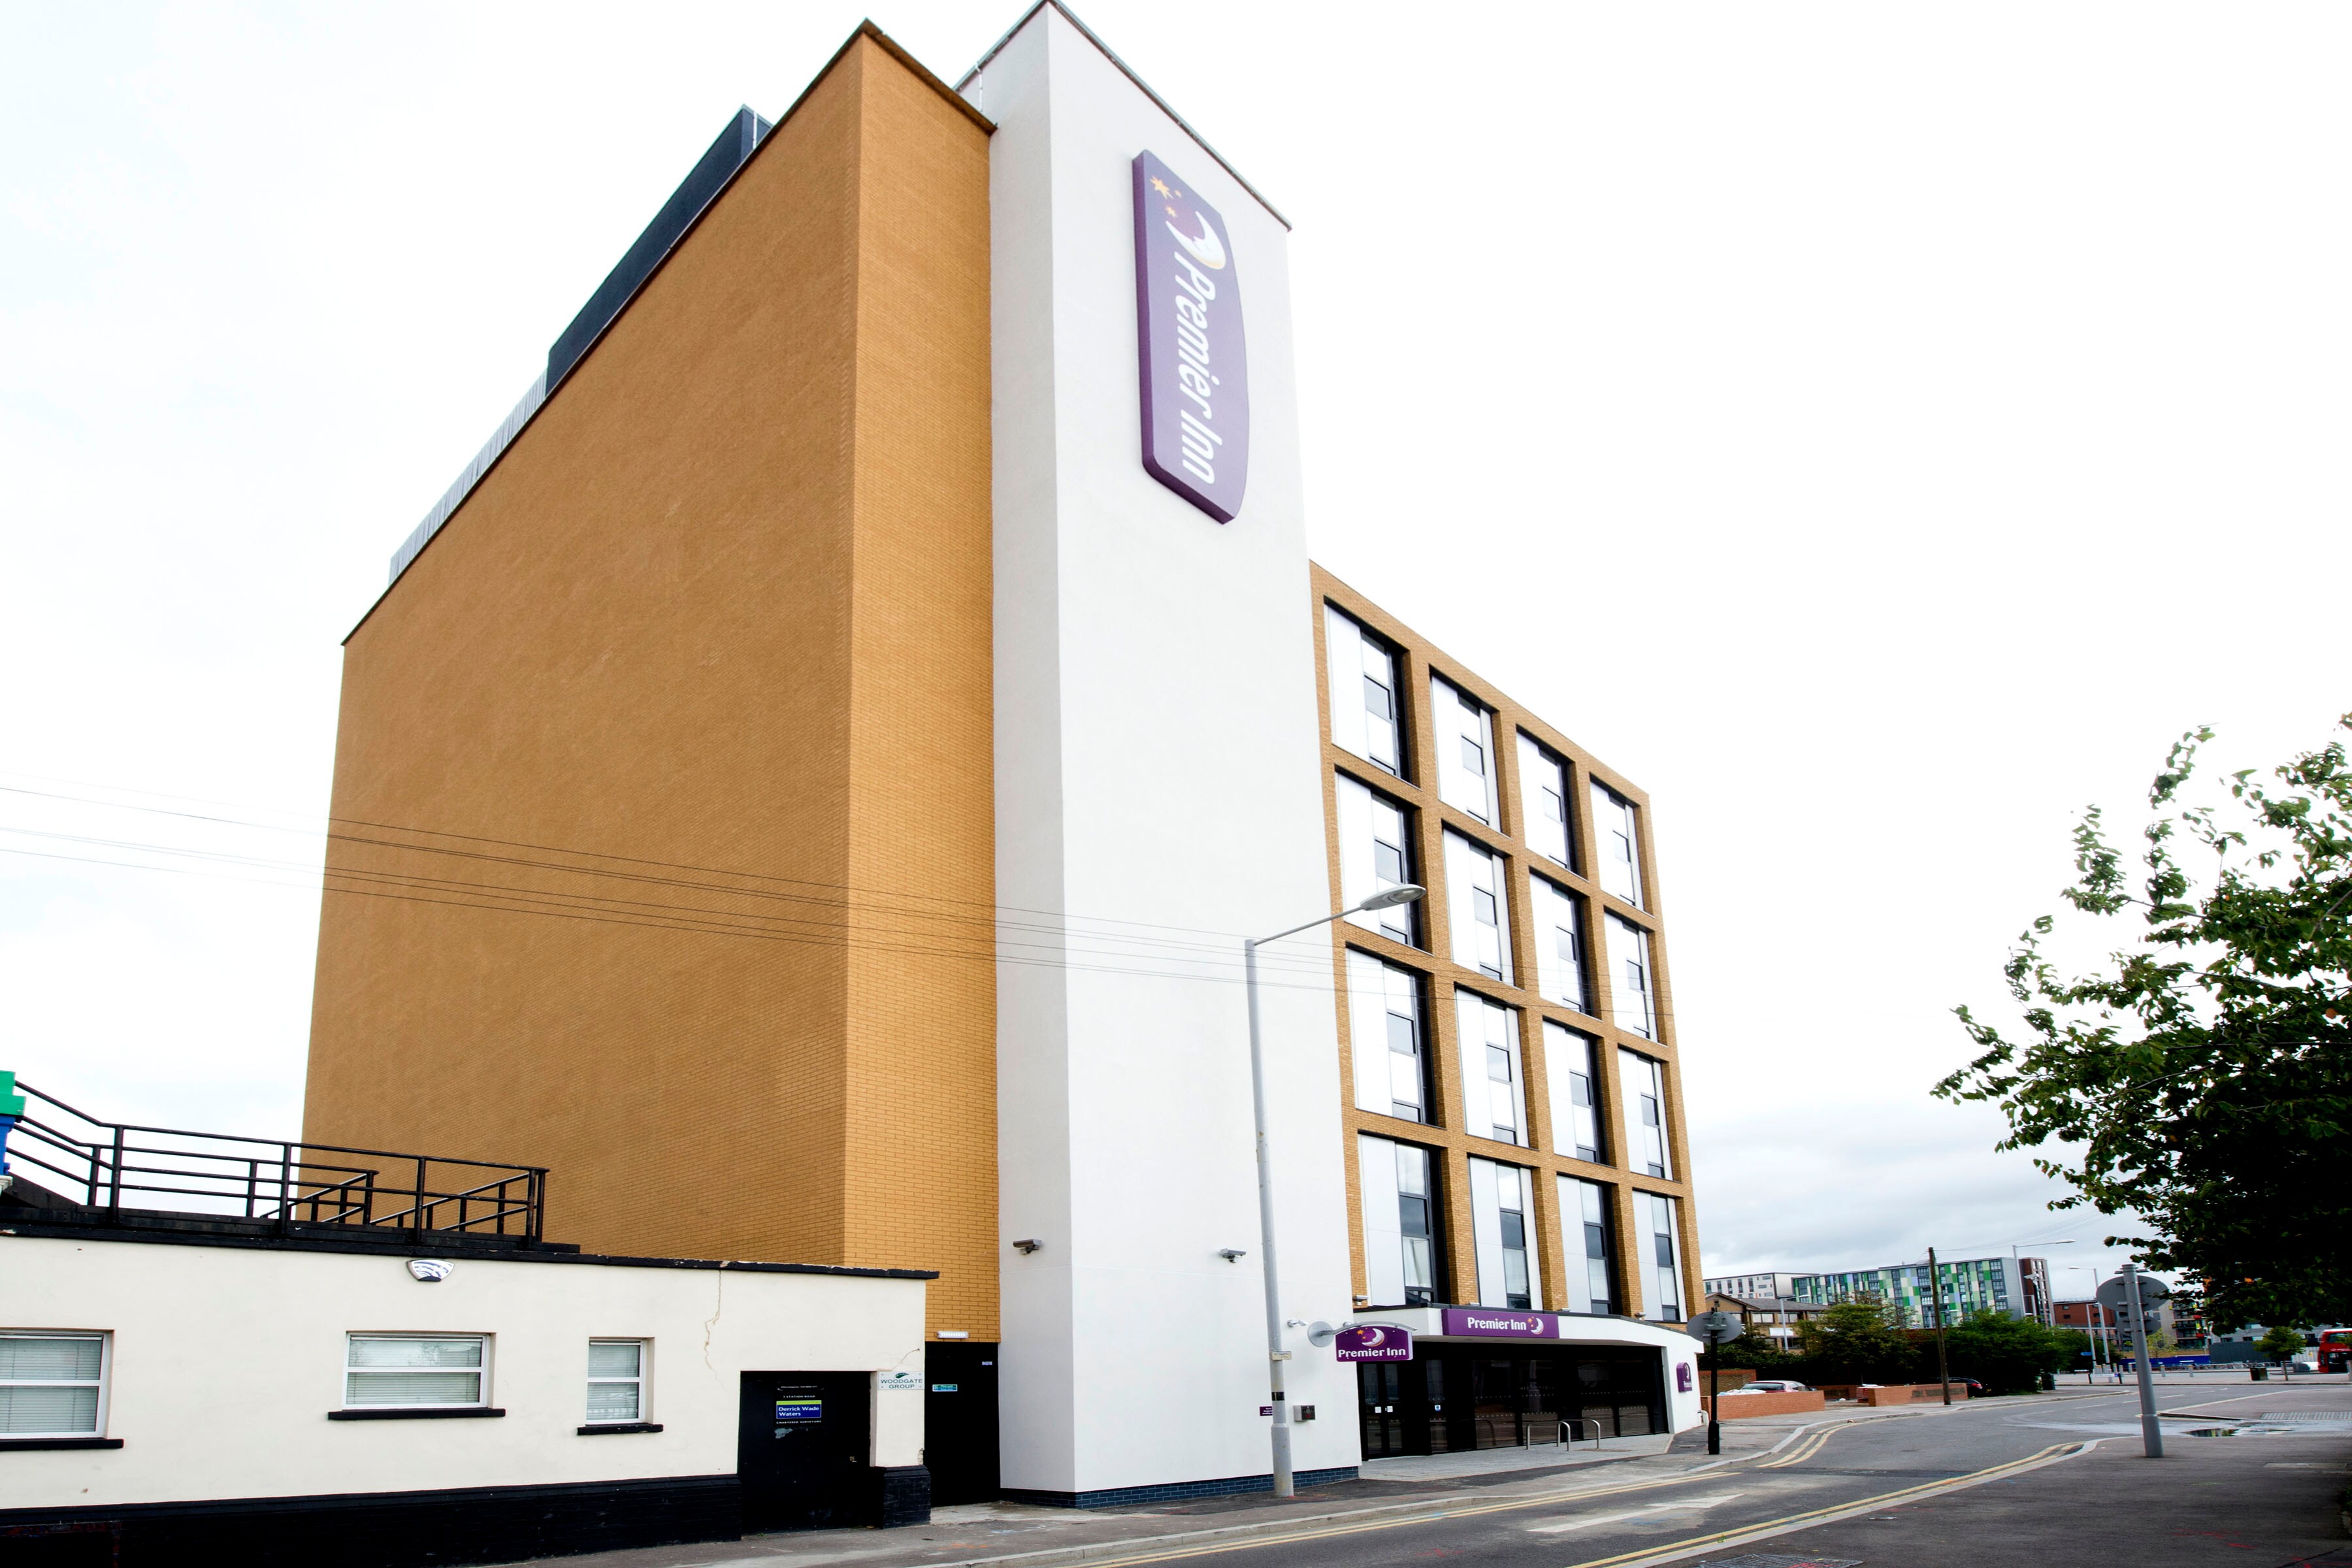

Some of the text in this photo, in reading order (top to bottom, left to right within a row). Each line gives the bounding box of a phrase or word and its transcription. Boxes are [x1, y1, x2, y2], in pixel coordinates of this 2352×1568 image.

[1174, 251, 1222, 485] Premier Inn
[1467, 1316, 1527, 1330] Premier Inn
[1338, 1347, 1406, 1358] Premier Inn
